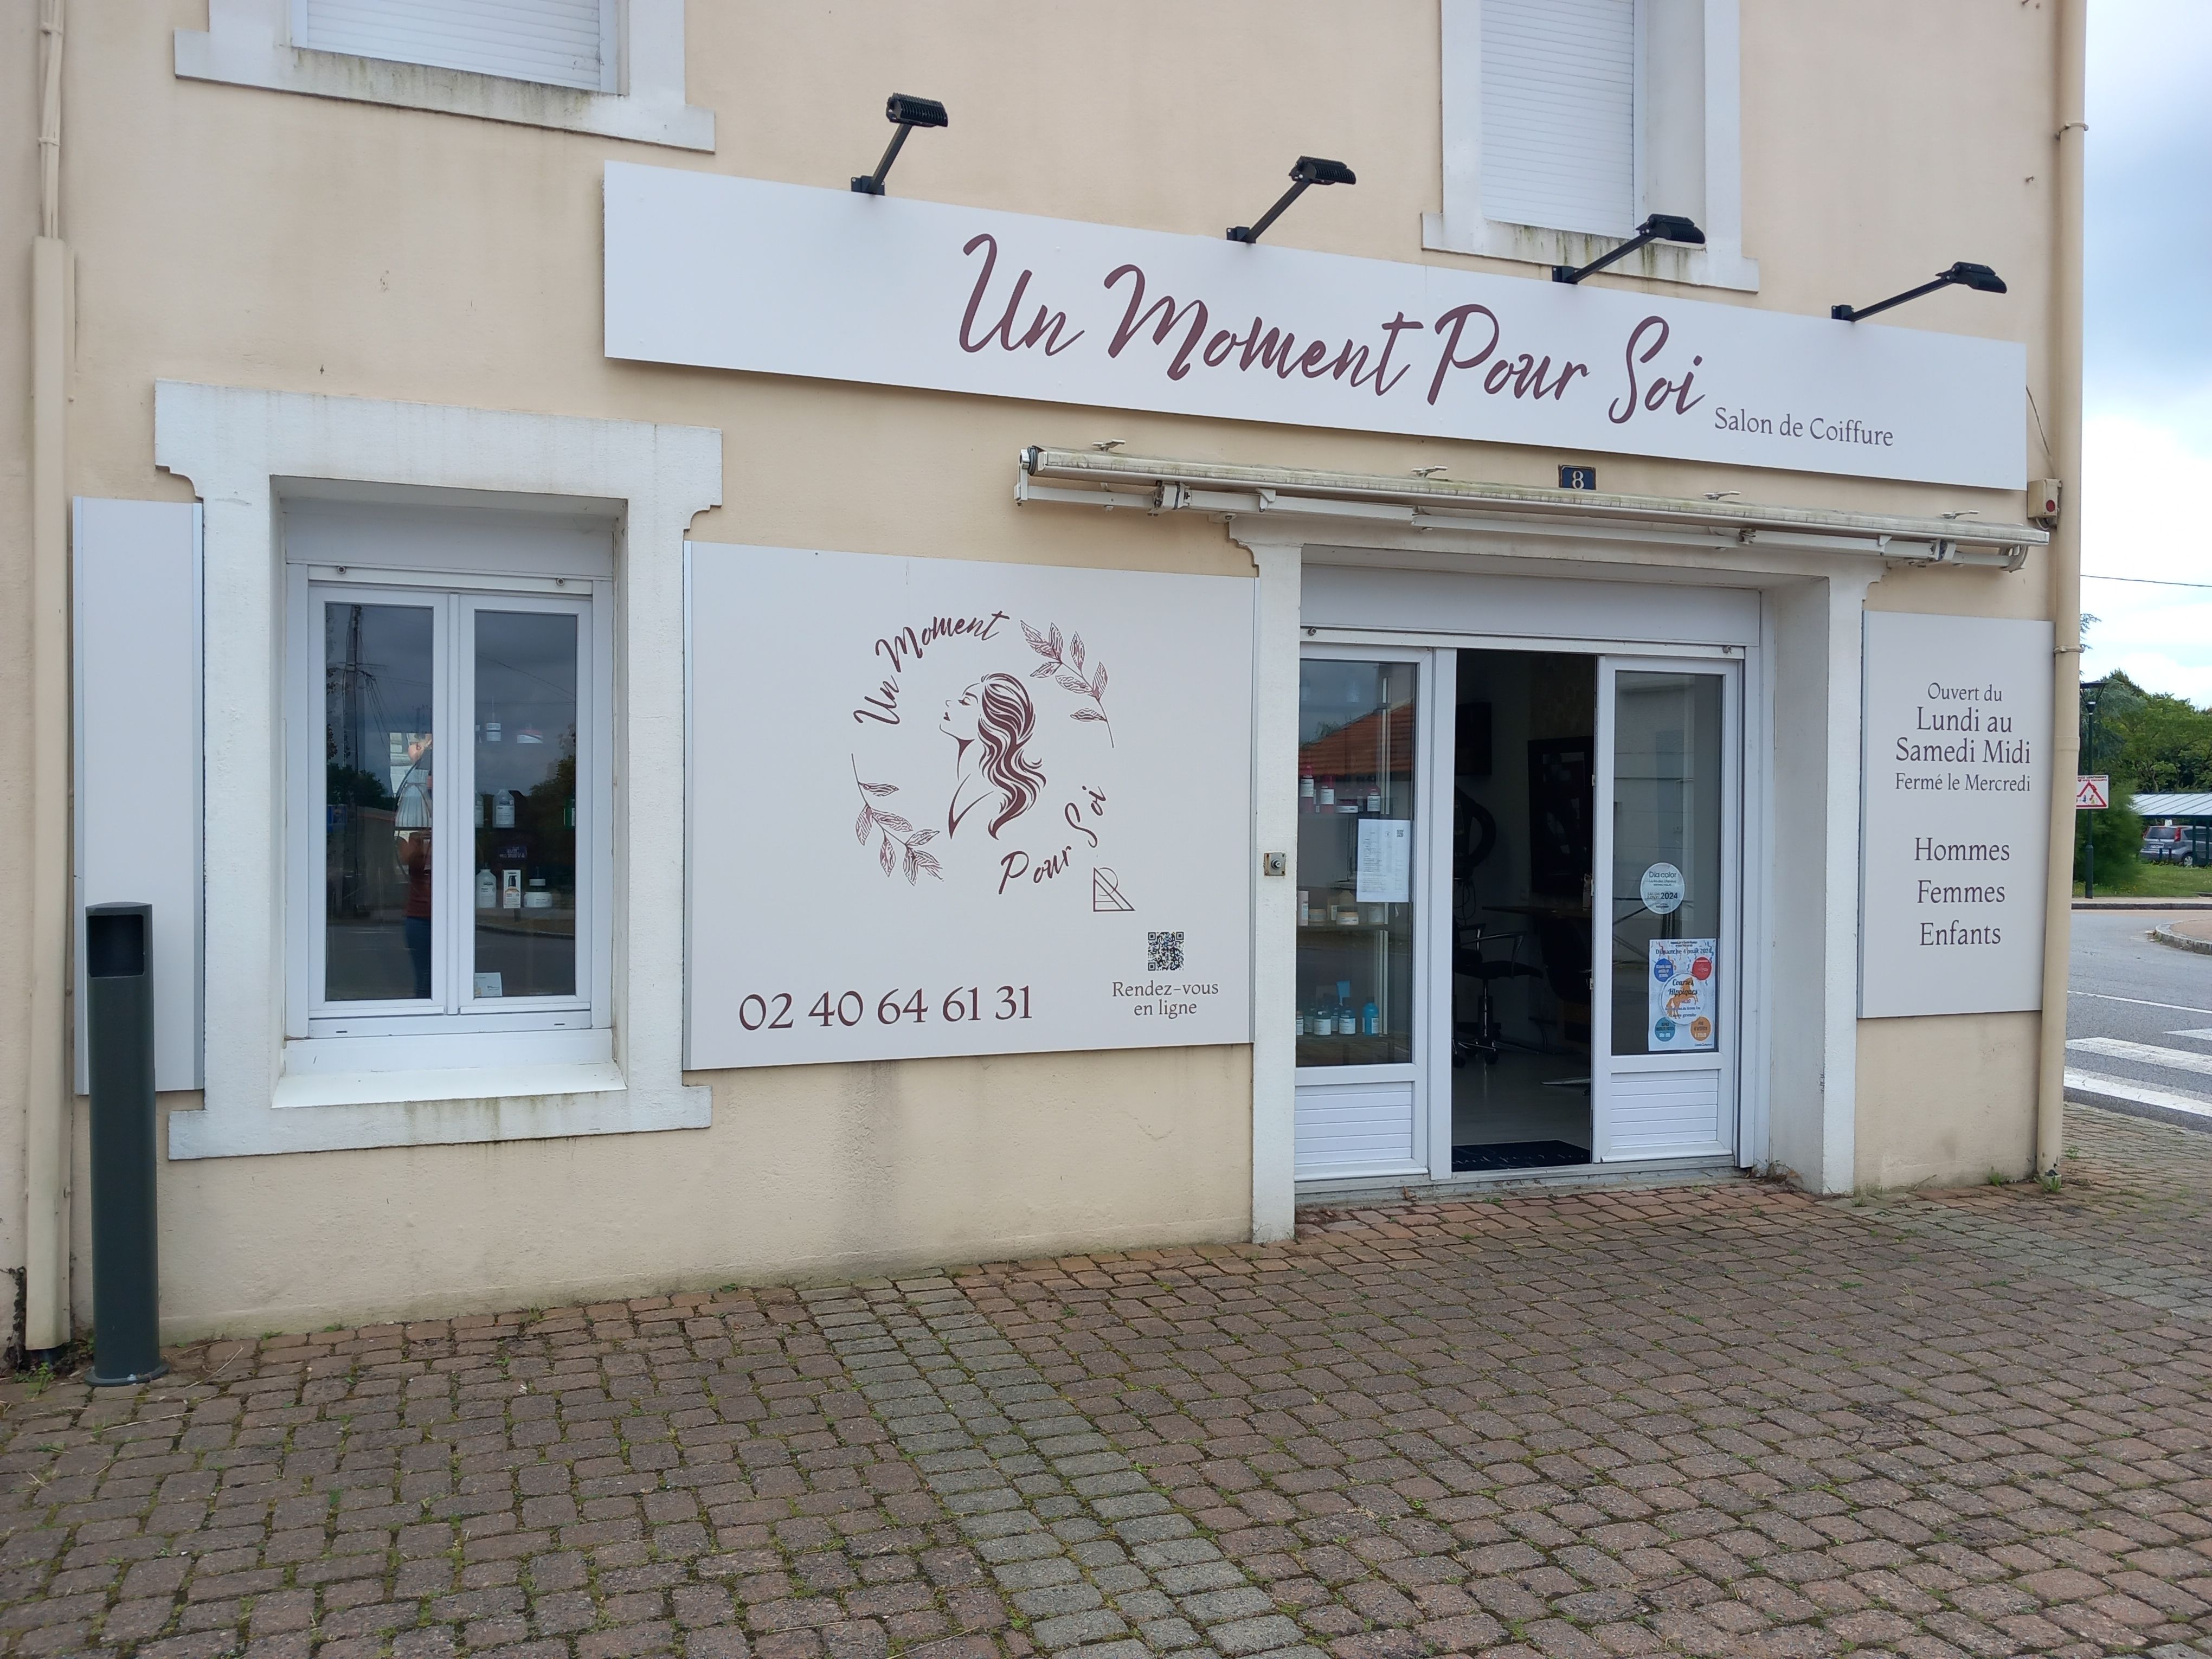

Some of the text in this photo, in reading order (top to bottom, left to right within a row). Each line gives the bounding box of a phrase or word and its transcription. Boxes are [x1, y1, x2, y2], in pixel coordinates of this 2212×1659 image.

[959, 234, 1705, 423] Un Moment Pour Soi
[1715, 407, 1893, 446] Salon de Coiffure
[1572, 471, 1584, 490] 8
[853, 610, 1009, 724] Un Moment
[1928, 683, 2002, 701] Ouvert du
[1917, 706, 2011, 732] Lundi au
[1896, 737, 2030, 763] Samedi Midi
[1896, 773, 2030, 791] Fermé le Mercredi
[999, 786, 1106, 895] Pour Soi
[1915, 838, 2009, 860] Hommes
[1918, 880, 2004, 903] Femmes
[1920, 920, 2001, 946] Enfants
[1113, 980, 1218, 996] Rendez-vous
[1668, 988, 1698, 997] Hippiques
[740, 986, 1032, 1030] 02 40 64 61 31
[1134, 999, 1197, 1019] en ligne
